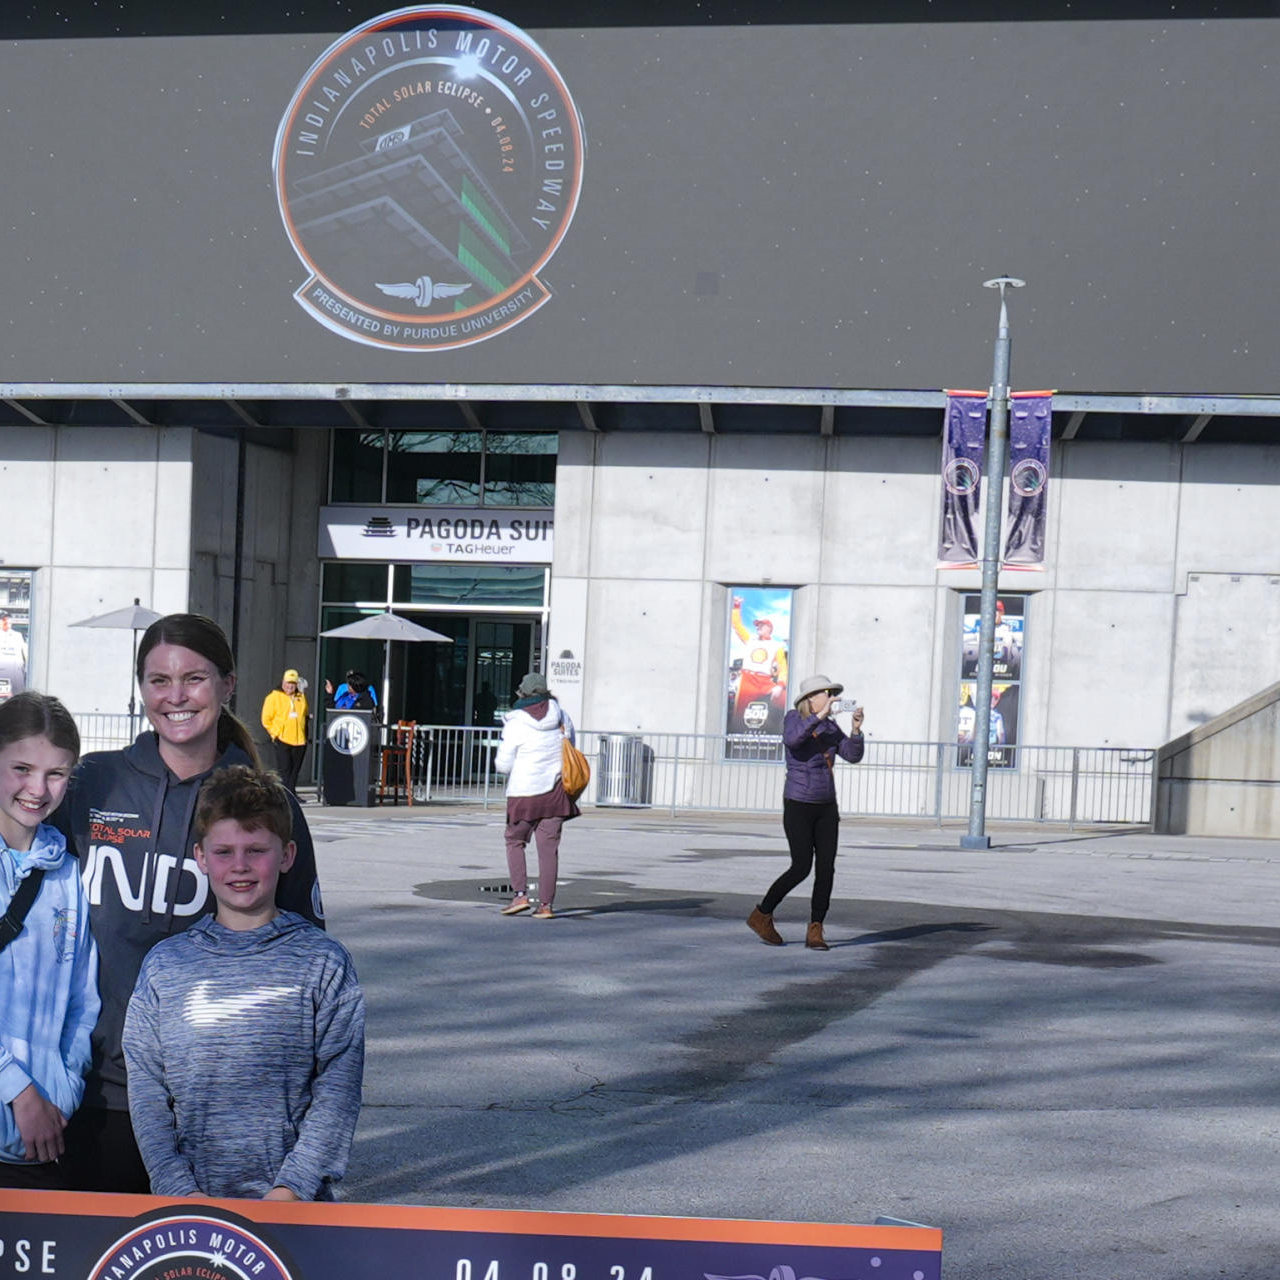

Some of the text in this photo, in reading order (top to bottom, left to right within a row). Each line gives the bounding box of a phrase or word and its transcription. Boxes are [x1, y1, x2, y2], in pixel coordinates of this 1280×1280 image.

[296, 28, 565, 231] INDIANAPOLIS MOTOR SPEEDWAY
[359, 80, 514, 172] TOTAL SOLAR ECLIPSE 04.08.24
[312, 287, 535, 339] PRESENTED BY PURDUE UNIVERSITY
[406, 517, 502, 540] PAGODA
[551, 661, 581, 669] PAGODA
[89, 823, 151, 838] OTAL SOLAR
[209, 1232, 266, 1275] MOTOR
[163, 1266, 193, 1280] SOLAR
